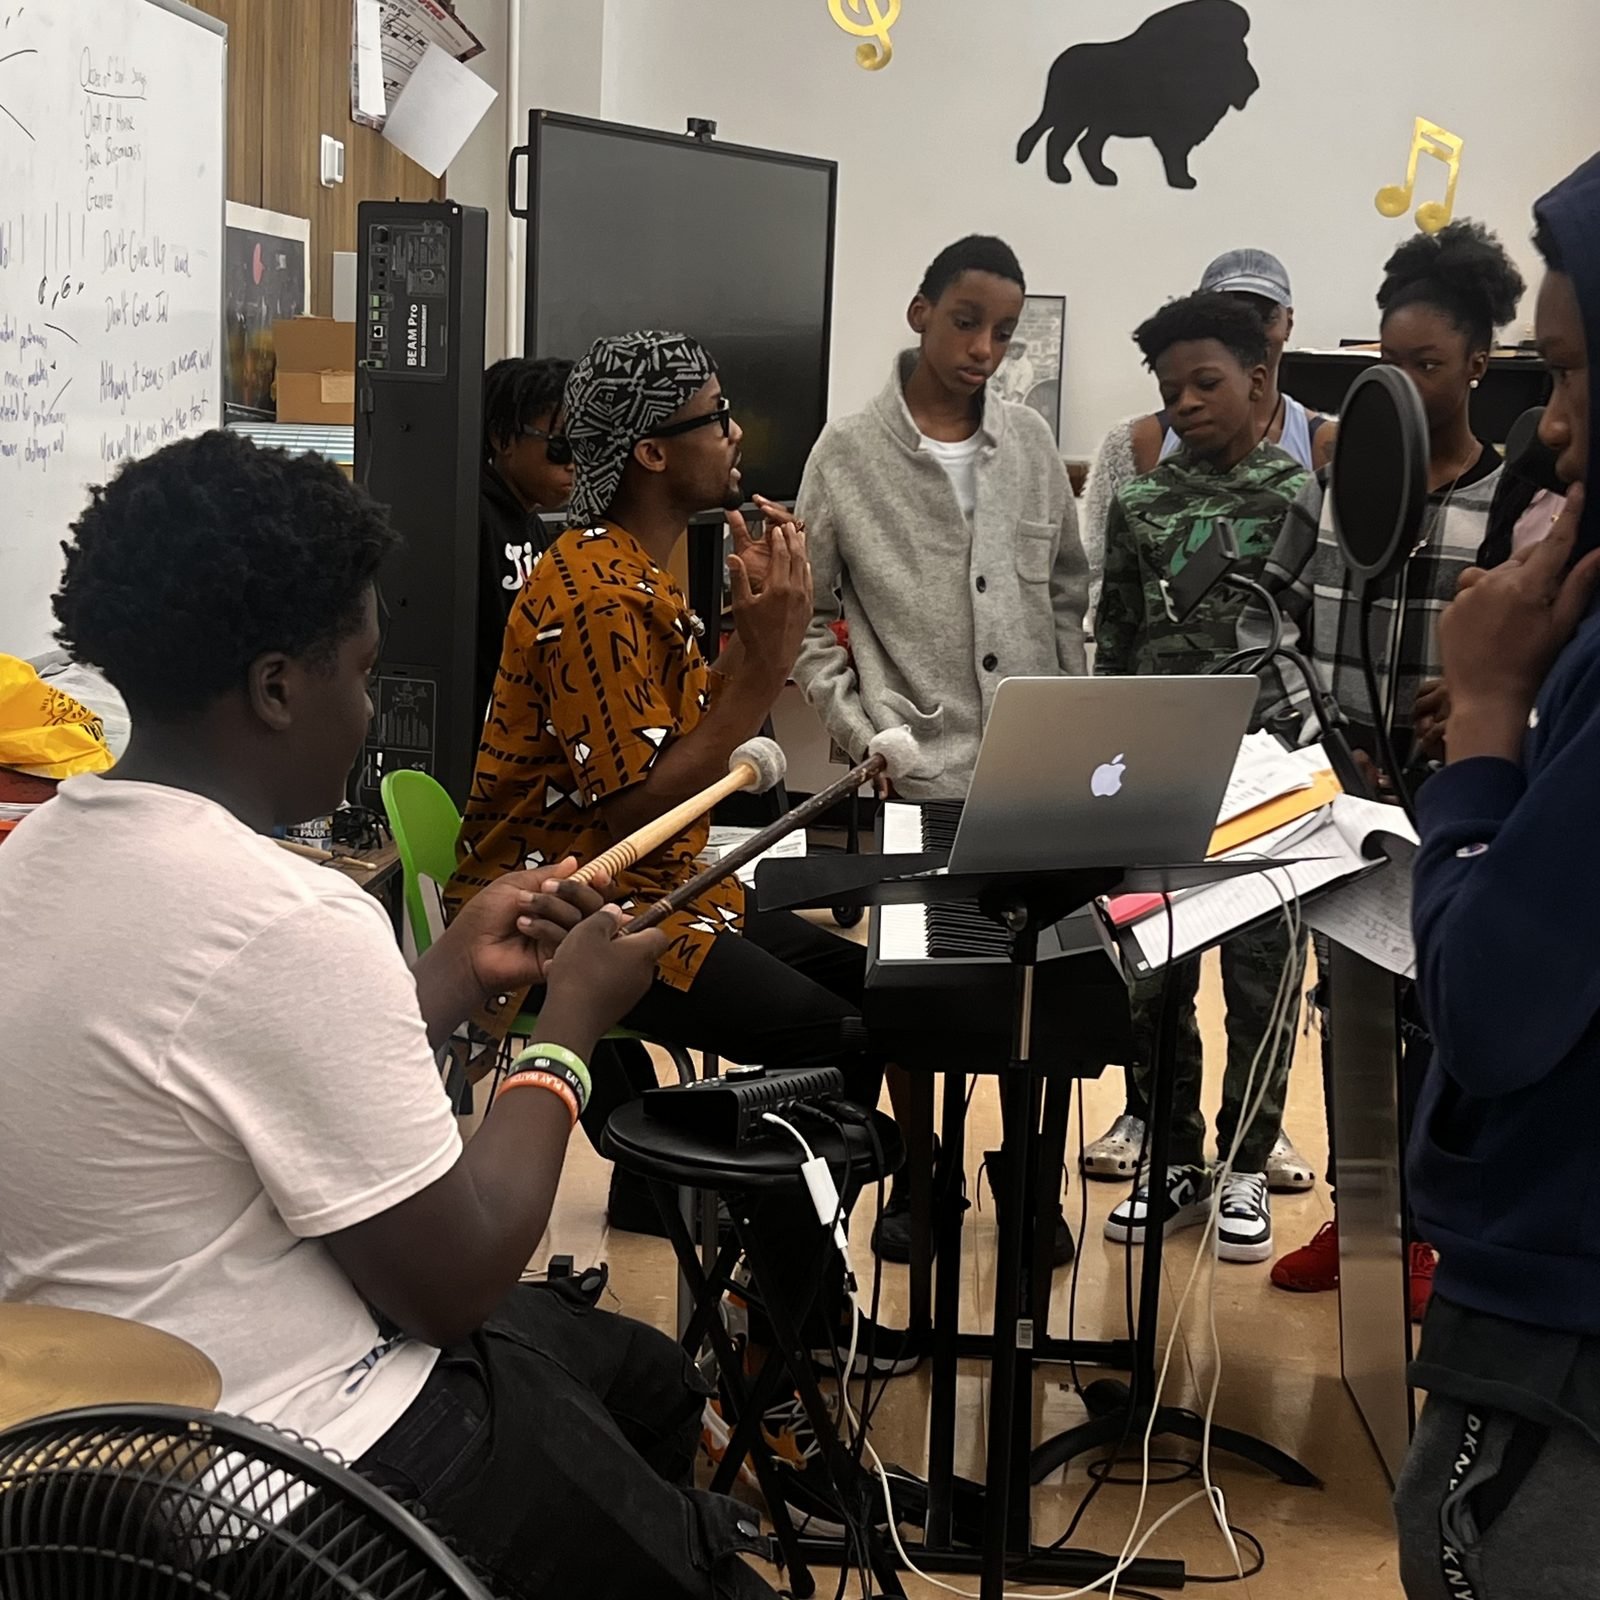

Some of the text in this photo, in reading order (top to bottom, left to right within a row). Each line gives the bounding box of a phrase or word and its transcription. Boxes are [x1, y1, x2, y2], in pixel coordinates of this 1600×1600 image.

[407, 304, 418, 366] BEAM Pro
[300, 829, 326, 838] PARK
[1443, 1545, 1475, 1600] KNY
